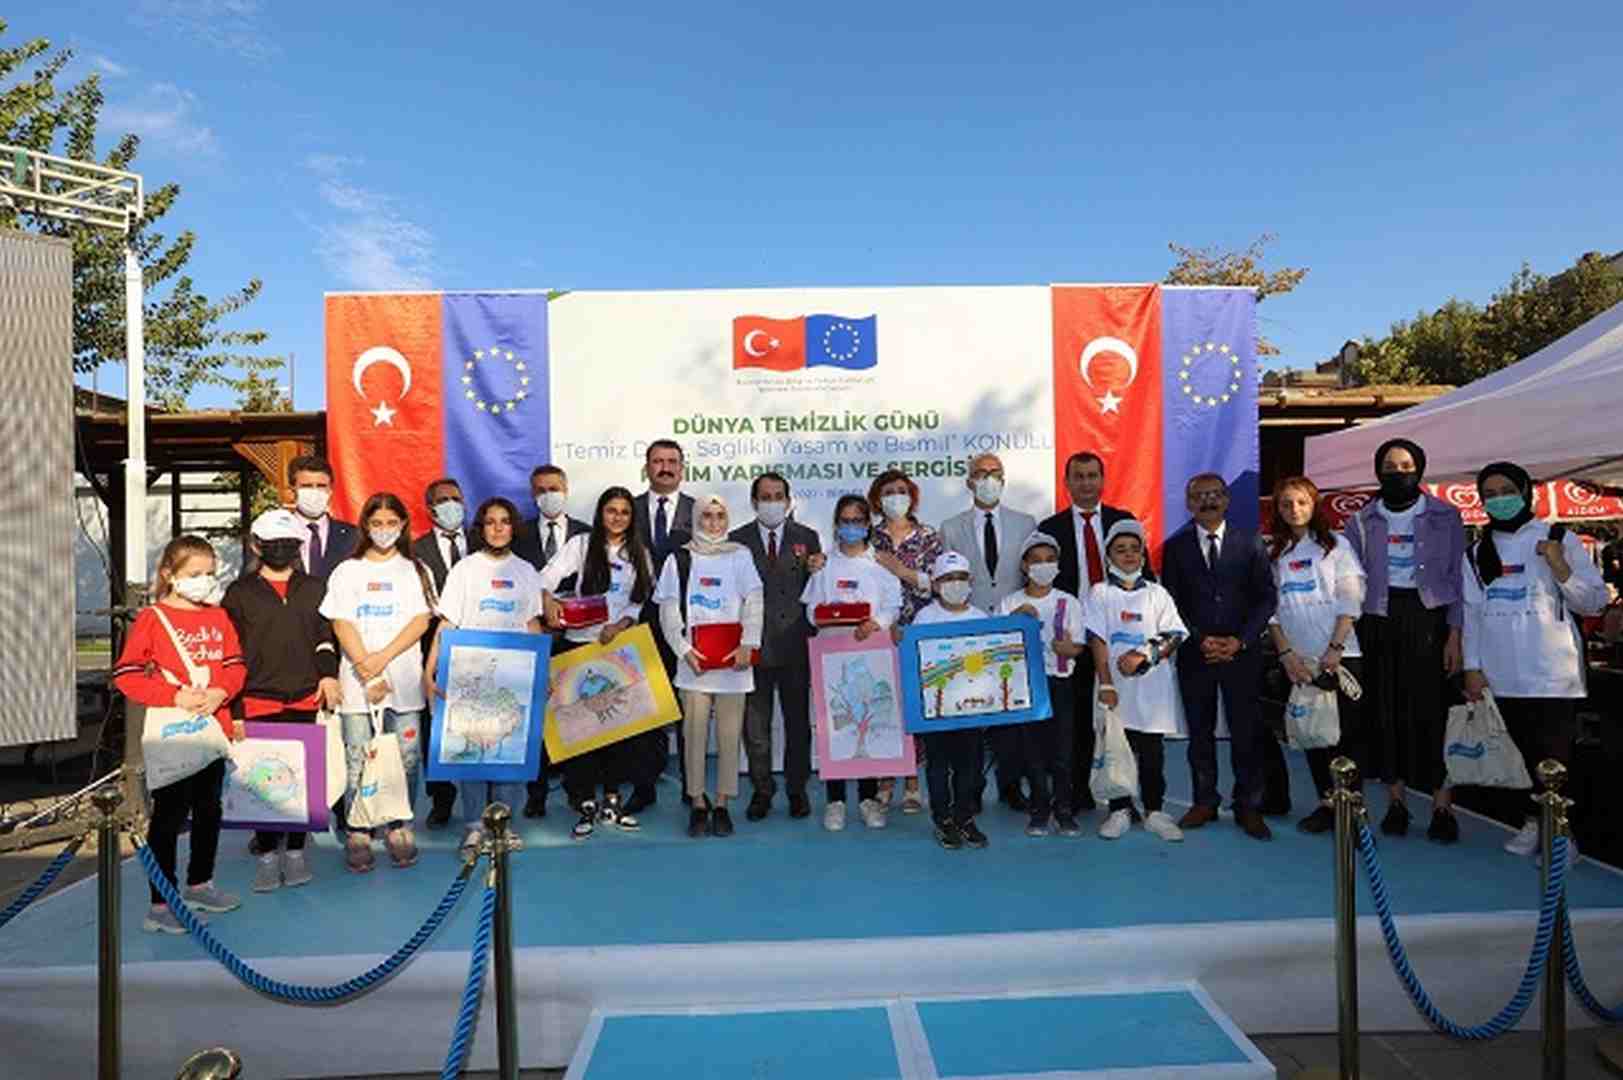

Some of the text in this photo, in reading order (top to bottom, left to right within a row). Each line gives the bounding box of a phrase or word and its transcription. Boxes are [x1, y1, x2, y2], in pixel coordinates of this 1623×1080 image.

[673, 409, 939, 434] DÜNYA TEMİZLİK GÜNÜ
[854, 439, 880, 454] ve
[849, 462, 880, 478] VE
